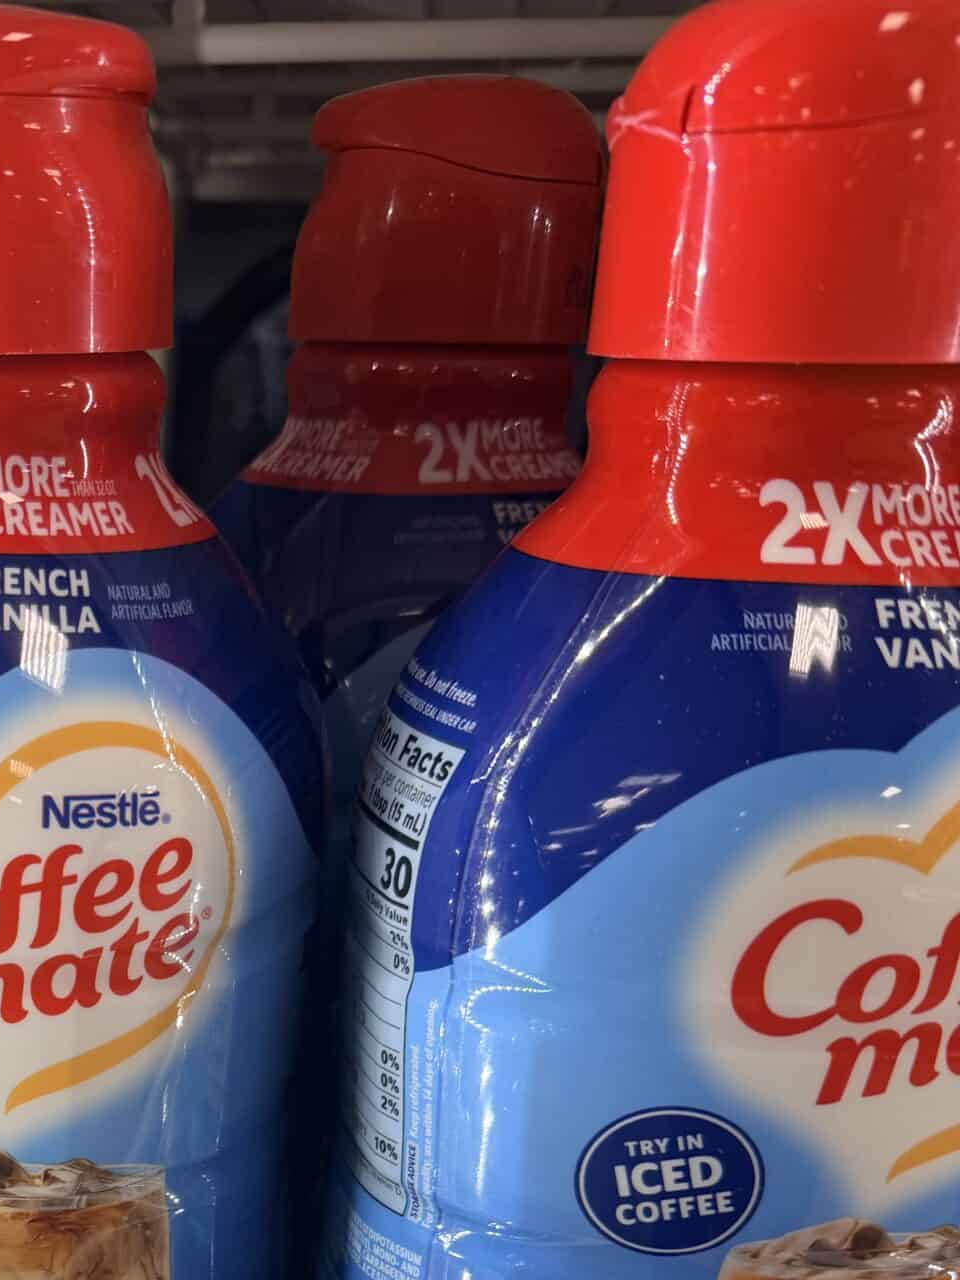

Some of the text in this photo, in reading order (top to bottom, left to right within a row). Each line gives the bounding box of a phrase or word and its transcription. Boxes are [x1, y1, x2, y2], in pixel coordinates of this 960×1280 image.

[759, 478, 883, 566] 2X
[872, 483, 960, 528] MORE
[880, 529, 960, 568] CRE
[107, 583, 151, 601] NATURAL
[711, 633, 792, 652] ARTIFICIAL
[398, 734, 455, 782] Facts
[380, 847, 413, 899] 30
[380, 1049, 400, 1071] 0%
[380, 1073, 400, 1094] 0%
[381, 1095, 400, 1117] 2%
[374, 1136, 398, 1161] 10%
[407, 1144, 417, 1178] ADVICE
[624, 1133, 704, 1157] TRY IN
[614, 1155, 724, 1198] ICED
[615, 1191, 735, 1225] COFFEE
